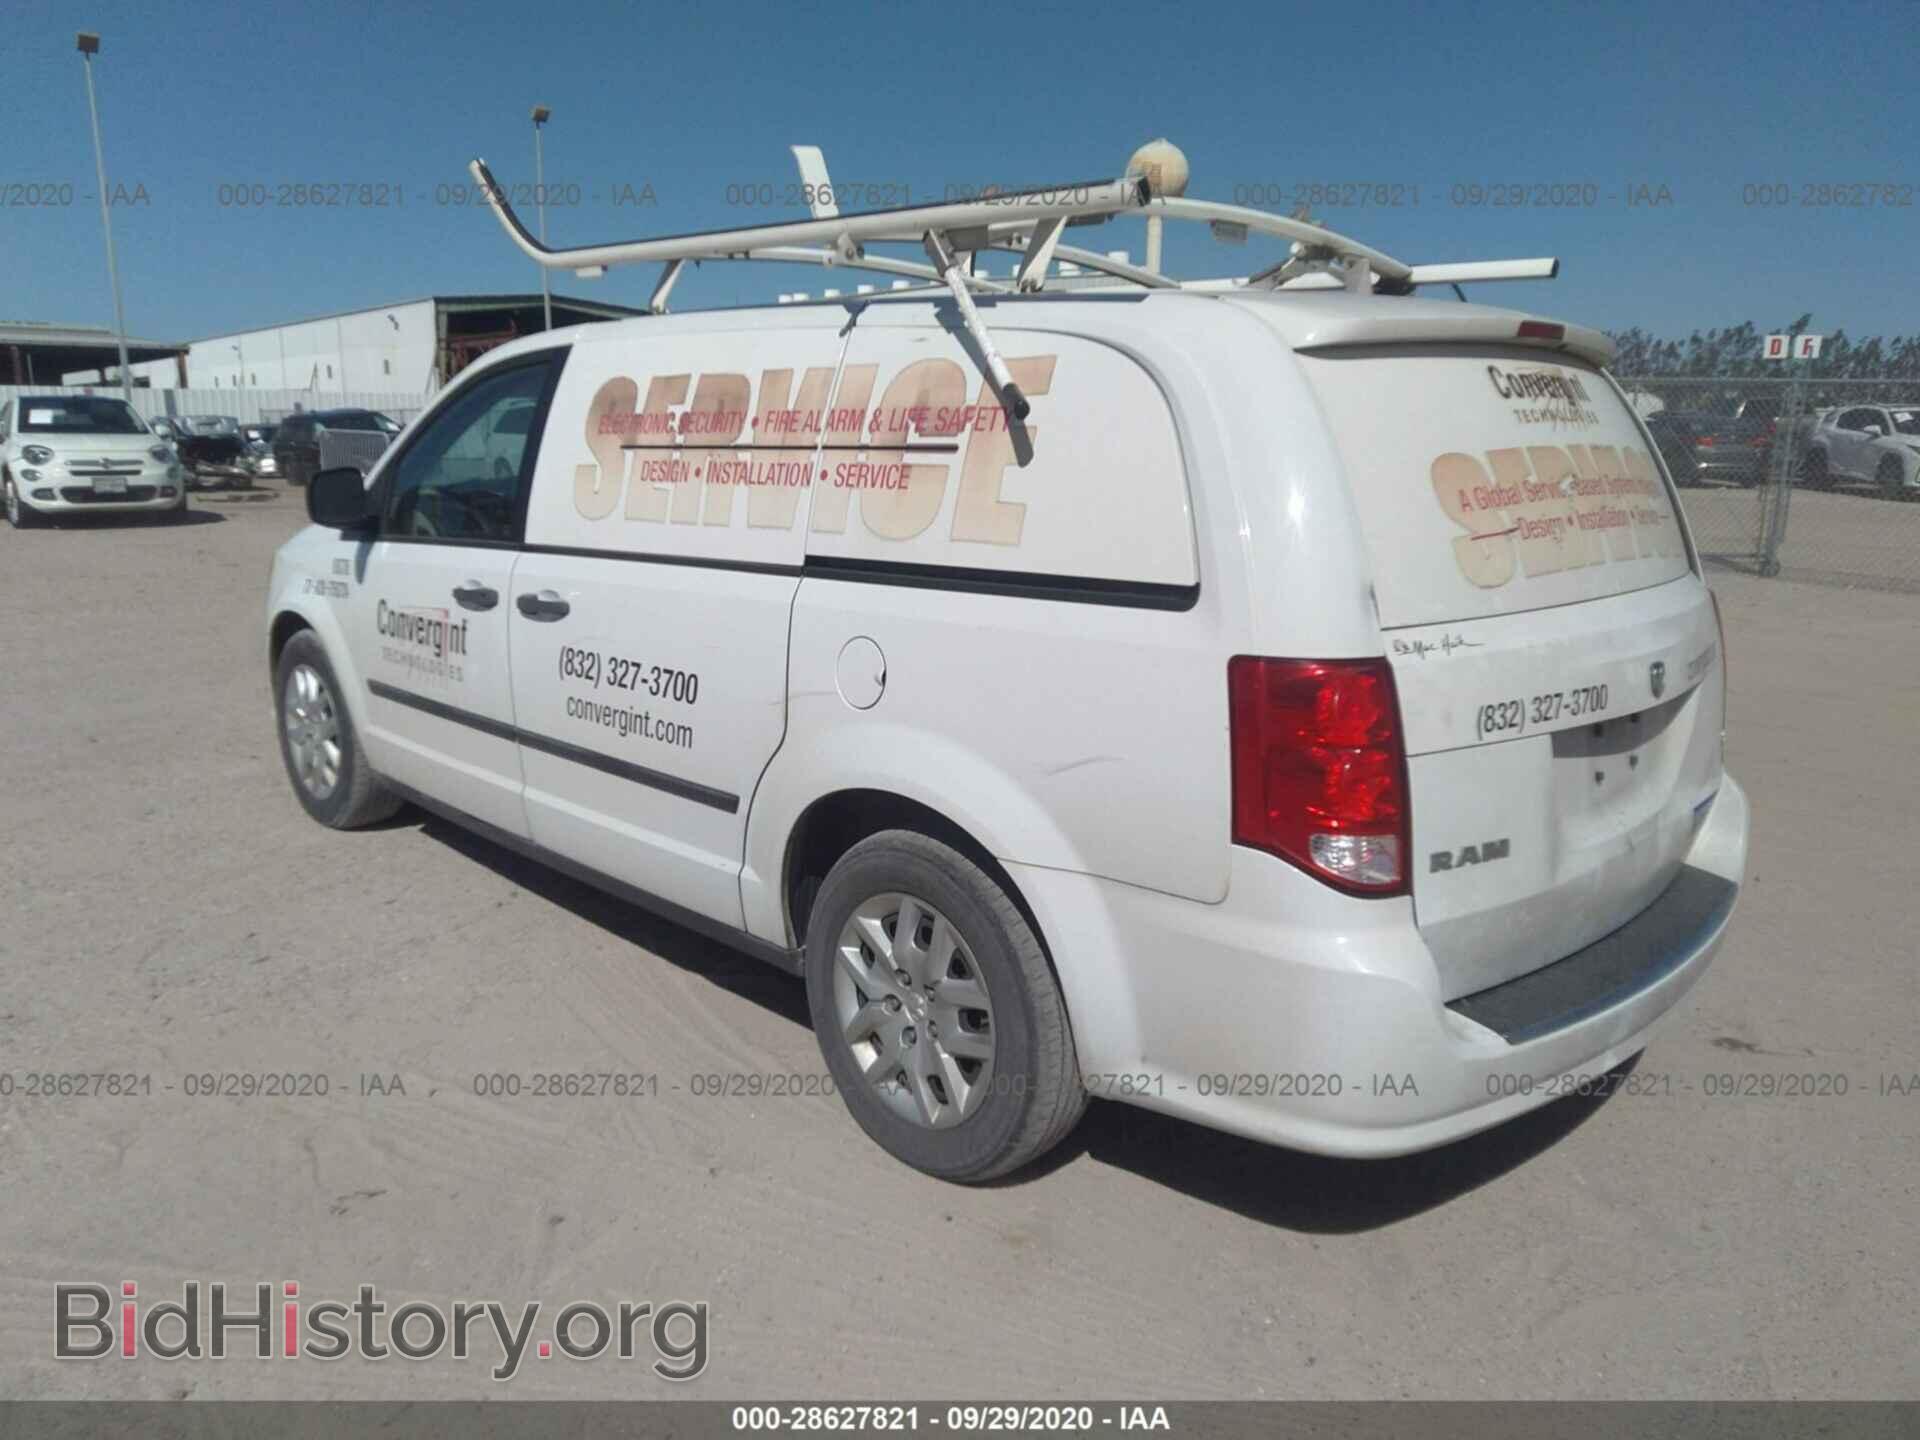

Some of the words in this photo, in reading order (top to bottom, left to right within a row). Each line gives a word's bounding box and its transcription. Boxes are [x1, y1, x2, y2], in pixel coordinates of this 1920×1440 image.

[678, 409, 748, 436] SECURITY
[764, 408, 800, 434] FIRE
[801, 407, 865, 433] ALARM
[868, 408, 883, 433] &
[888, 405, 930, 433] LIFE
[640, 459, 690, 483] DESIGN
[706, 460, 814, 488] INSTALLATION
[833, 462, 912, 491] SERVICE
[376, 598, 469, 658] Convergint
[558, 645, 602, 689] (832)
[606, 656, 699, 705] 327-3700
[566, 696, 694, 749] convergint.com
[1475, 699, 1526, 741] (832)
[1531, 683, 1609, 724] 327-3700
[1428, 838, 1511, 875] RAM
